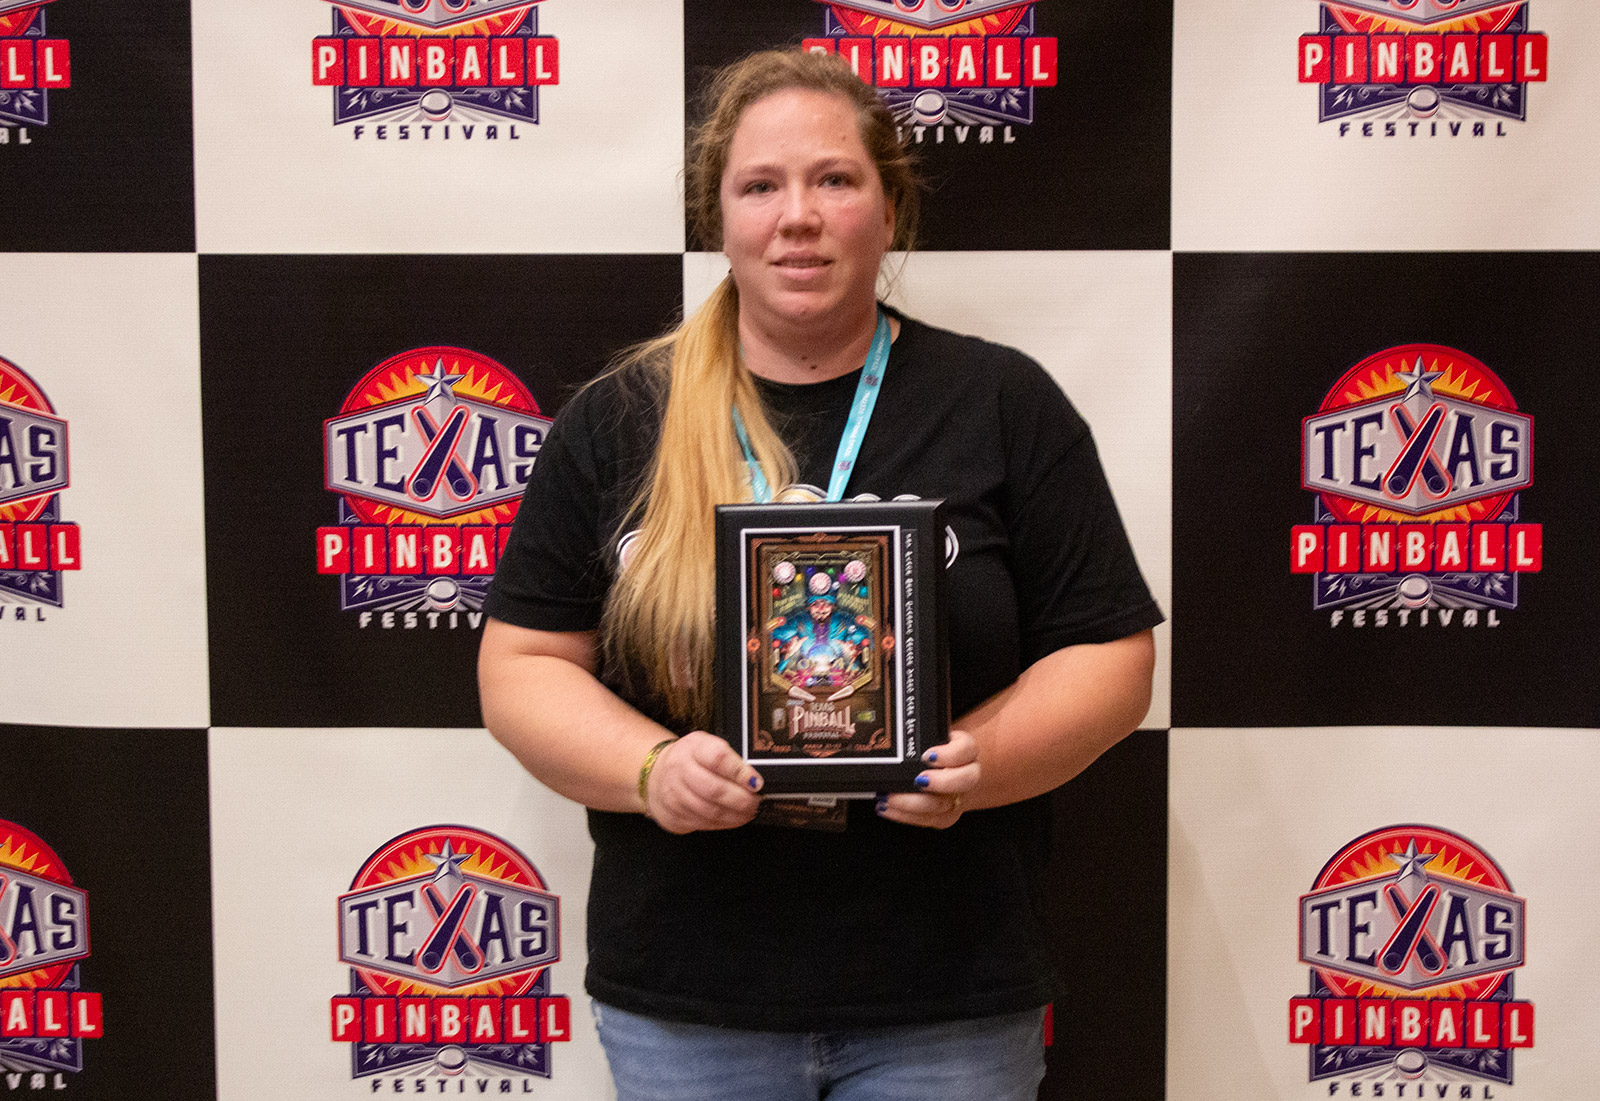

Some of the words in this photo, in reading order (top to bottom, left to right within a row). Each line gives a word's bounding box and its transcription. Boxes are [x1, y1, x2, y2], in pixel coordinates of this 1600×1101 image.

[319, 45, 552, 81] PINBALL
[810, 45, 1049, 81] INBALL
[1304, 41, 1540, 78] PINBALL
[354, 124, 520, 141] FESTIVAL
[1339, 121, 1507, 137] FESTIVAL
[1315, 403, 1520, 500] TEXAS
[1298, 531, 1533, 567] PINBALL
[1330, 609, 1500, 628] FESTIVAL
[790, 705, 856, 737] PINBALL
[349, 882, 549, 975] TEXAS
[1310, 882, 1514, 976] TEXAS
[336, 1003, 564, 1037] PINBALL
[1295, 1005, 1527, 1043] PINBALL
[371, 1079, 533, 1093] FESTIVAL
[1328, 1081, 1494, 1100] FESTIVAL
